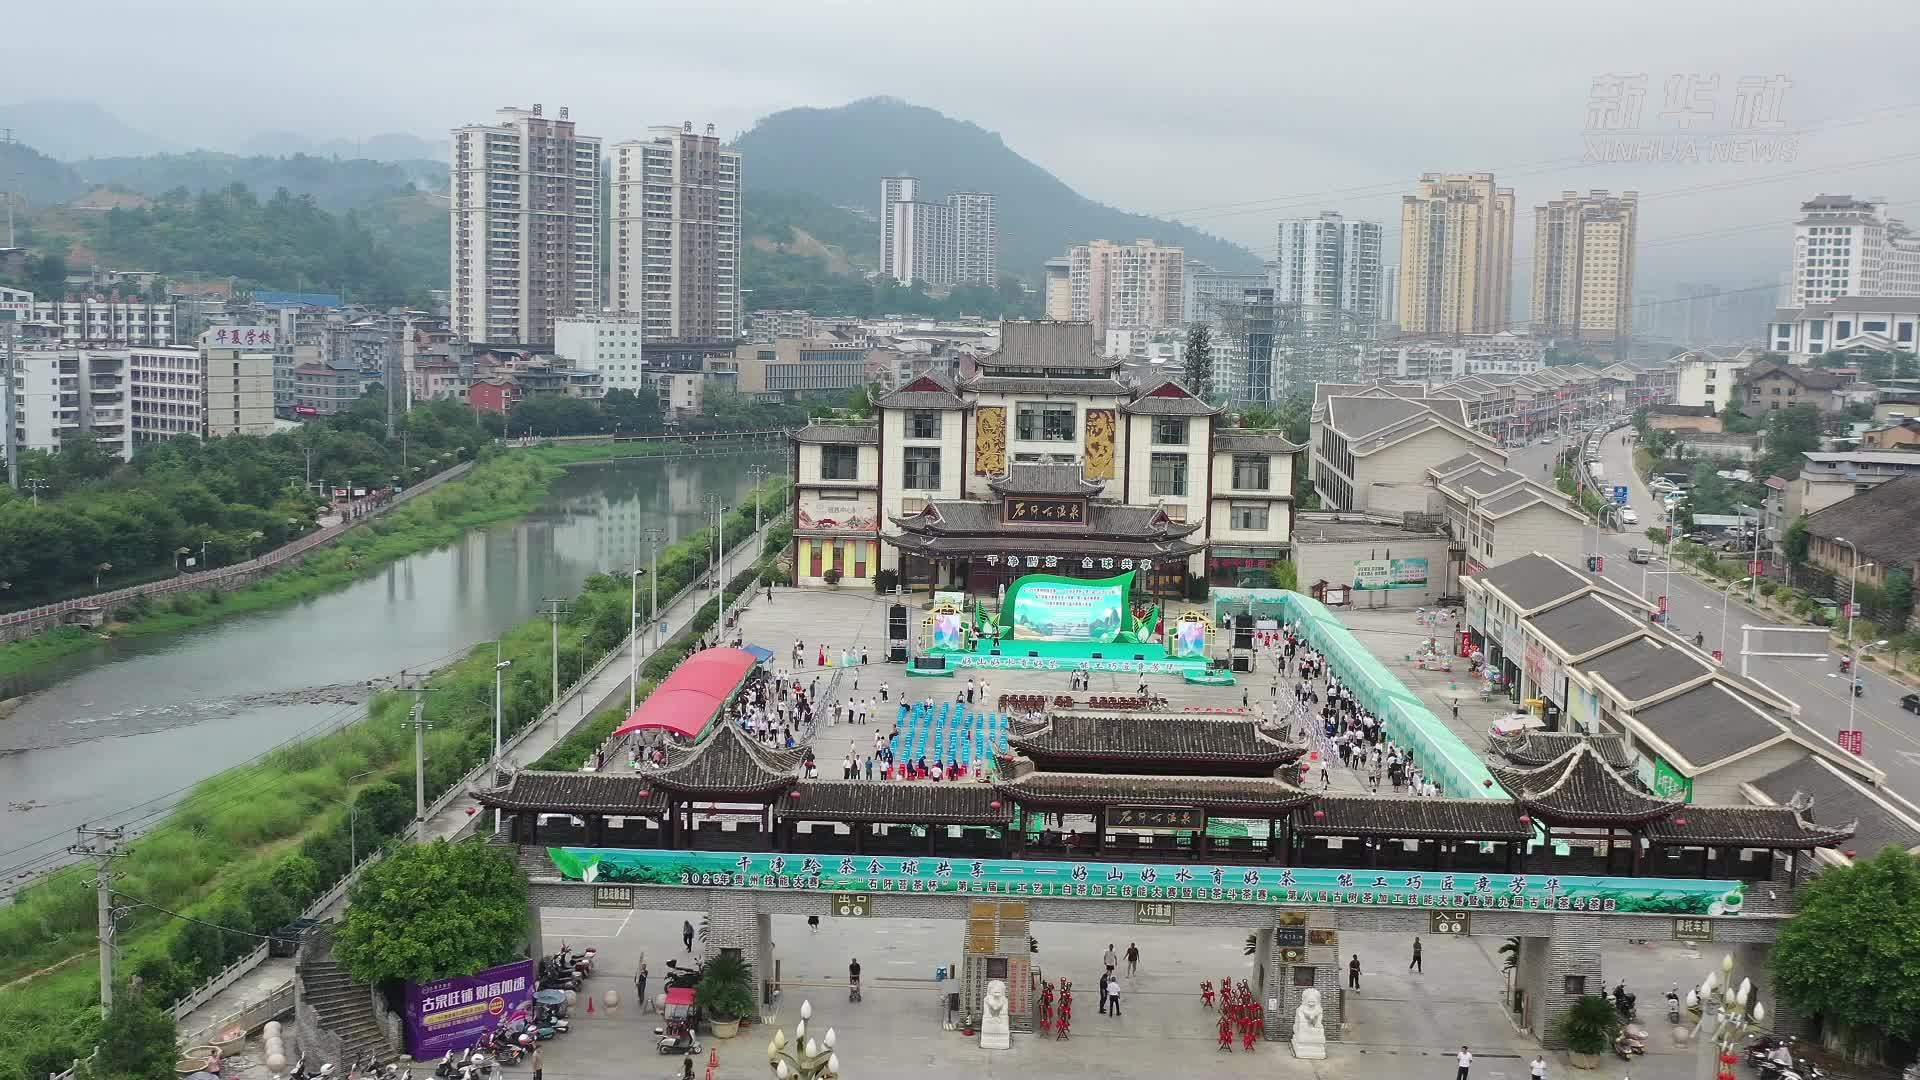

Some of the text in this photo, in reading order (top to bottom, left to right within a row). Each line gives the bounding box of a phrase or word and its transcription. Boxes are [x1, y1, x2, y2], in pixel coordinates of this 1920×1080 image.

[215, 328, 273, 346] 华夏学校
[986, 554, 1153, 571] 干净黔茶 全球共享
[838, 894, 867, 903] 出口
[1138, 903, 1171, 917] 人行通道
[1435, 911, 1466, 920] 入口
[421, 987, 474, 1013] 古泉旺铺
[475, 976, 526, 1001] 财富加速
